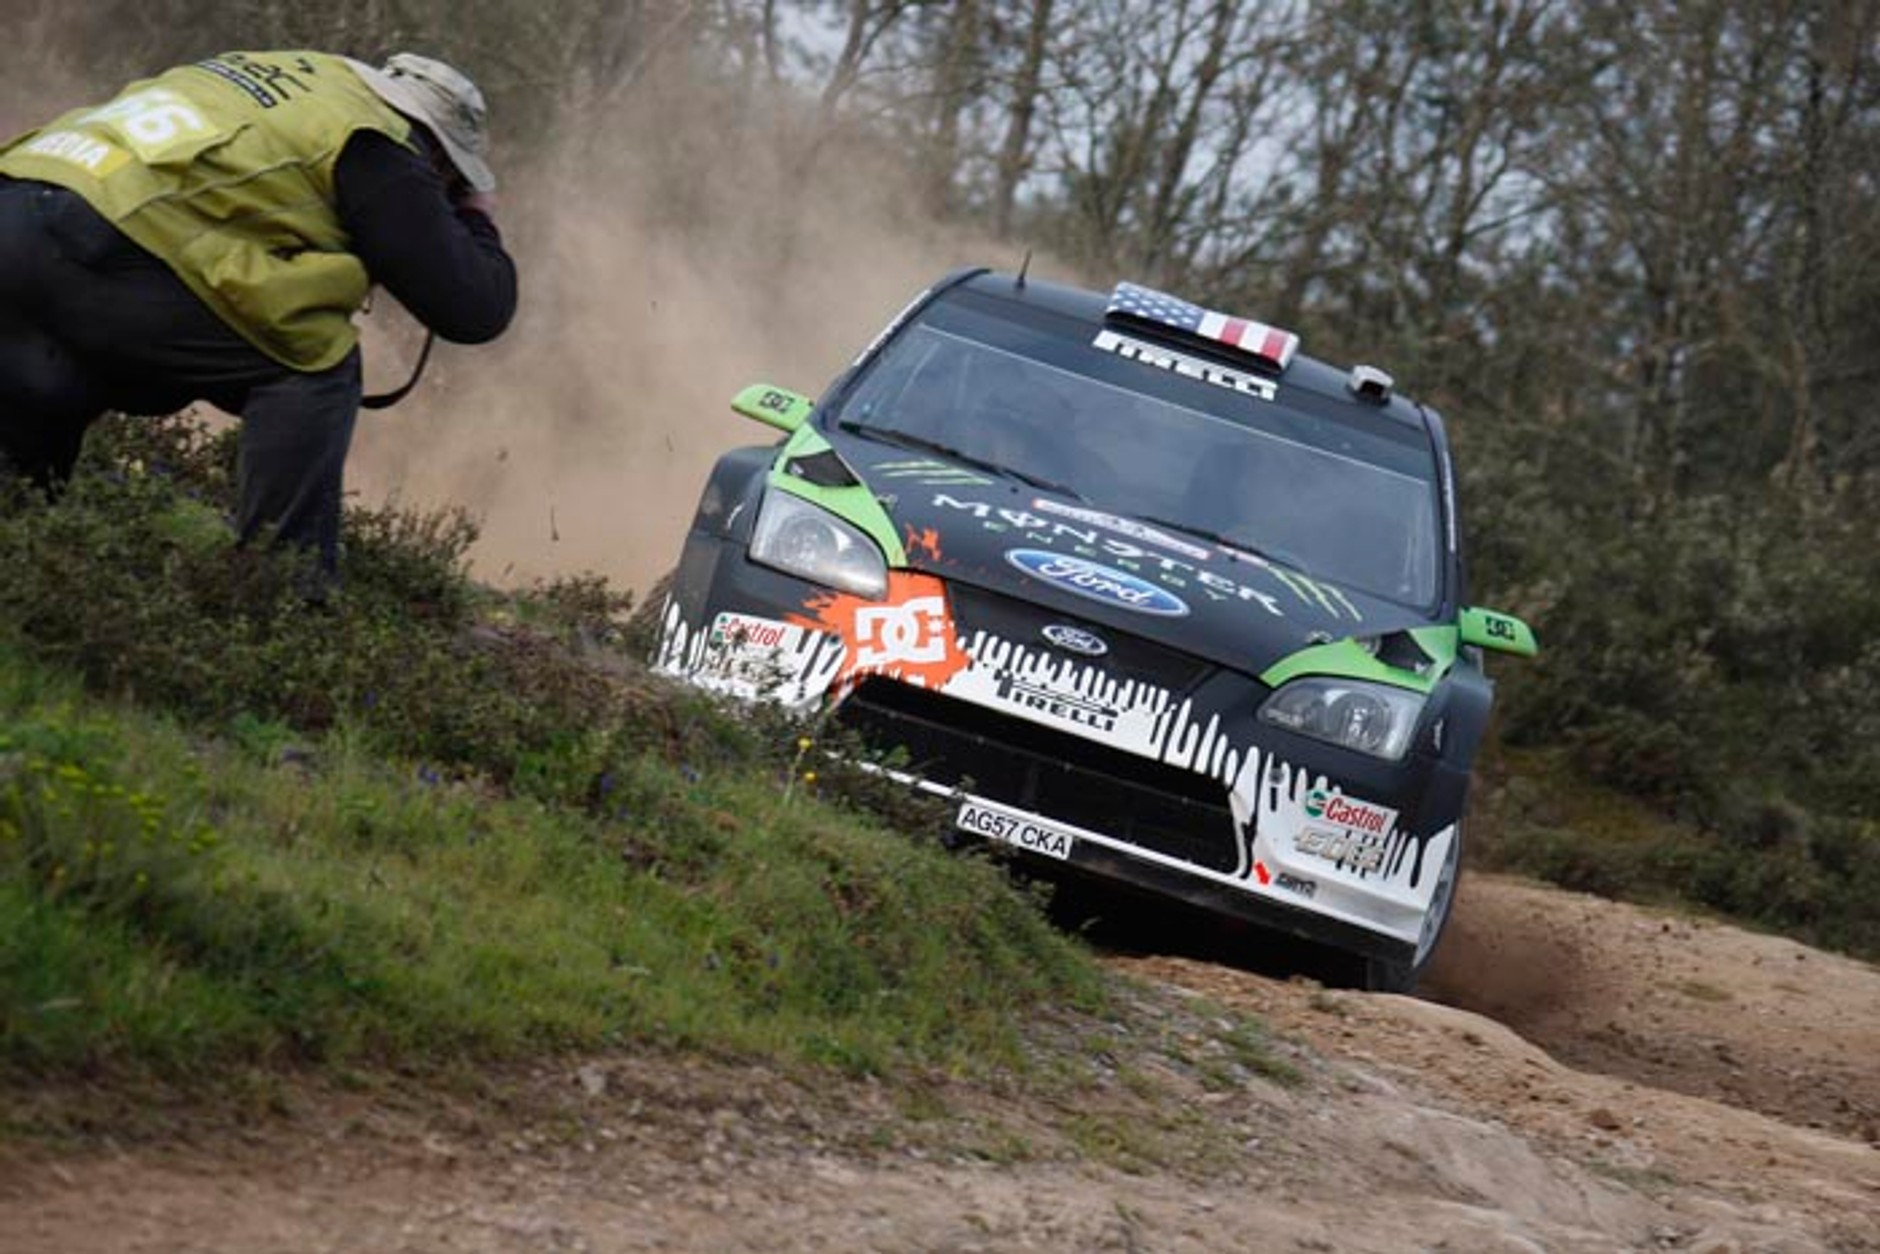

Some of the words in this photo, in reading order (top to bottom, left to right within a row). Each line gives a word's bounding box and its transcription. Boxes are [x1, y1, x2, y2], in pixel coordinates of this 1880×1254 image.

[932, 493, 1285, 617] MONSTER
[1038, 557, 1153, 605] Ford
[855, 595, 946, 666] DC
[993, 668, 1118, 732] PIRELLI
[961, 807, 1019, 839] AG57
[1021, 823, 1067, 855] CKA
[1325, 796, 1388, 834] Castrol
